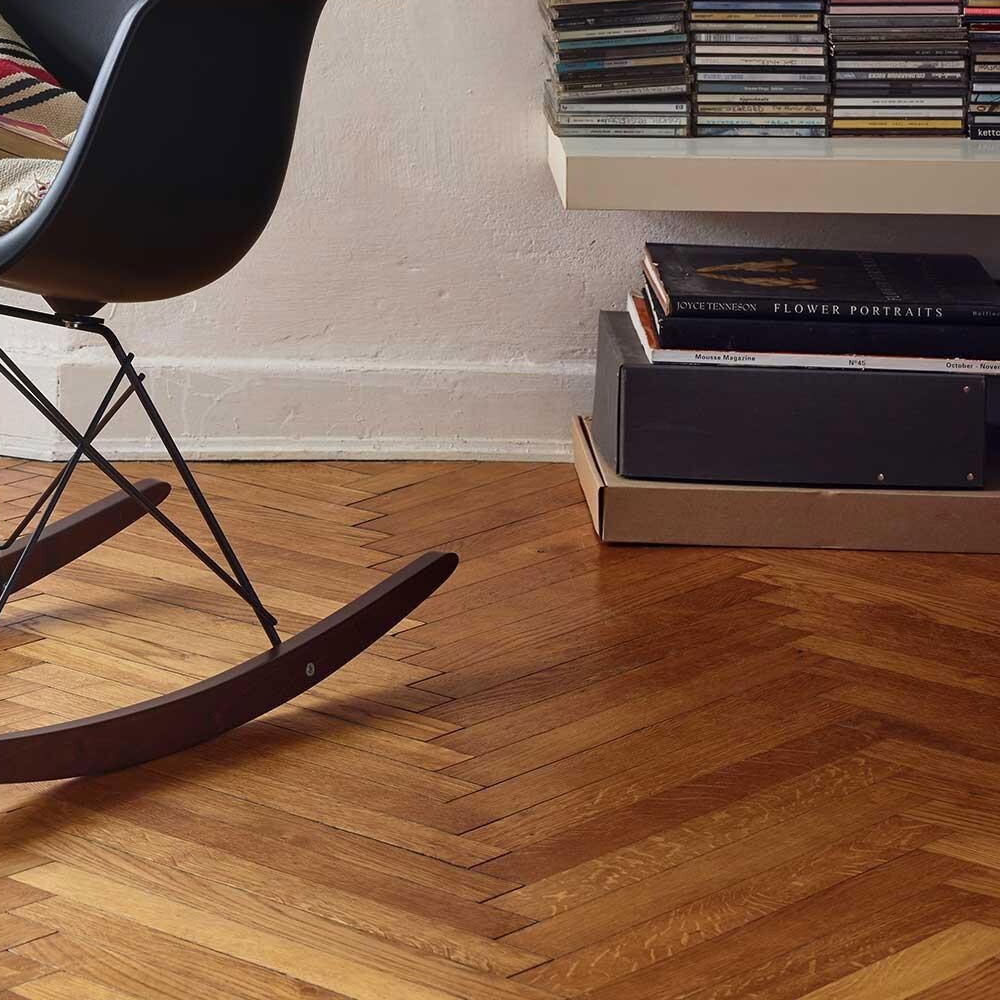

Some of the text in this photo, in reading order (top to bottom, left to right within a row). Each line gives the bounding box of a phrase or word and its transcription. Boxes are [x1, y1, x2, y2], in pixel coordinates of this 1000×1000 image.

[677, 301, 705, 311] JOYCE
[706, 302, 757, 312] TENNESON
[774, 303, 840, 315] FLOWER
[850, 305, 944, 318] PORTRAITS
[694, 353, 721, 361] Mousse
[722, 354, 756, 362] Magazine
[946, 361, 973, 369] October
